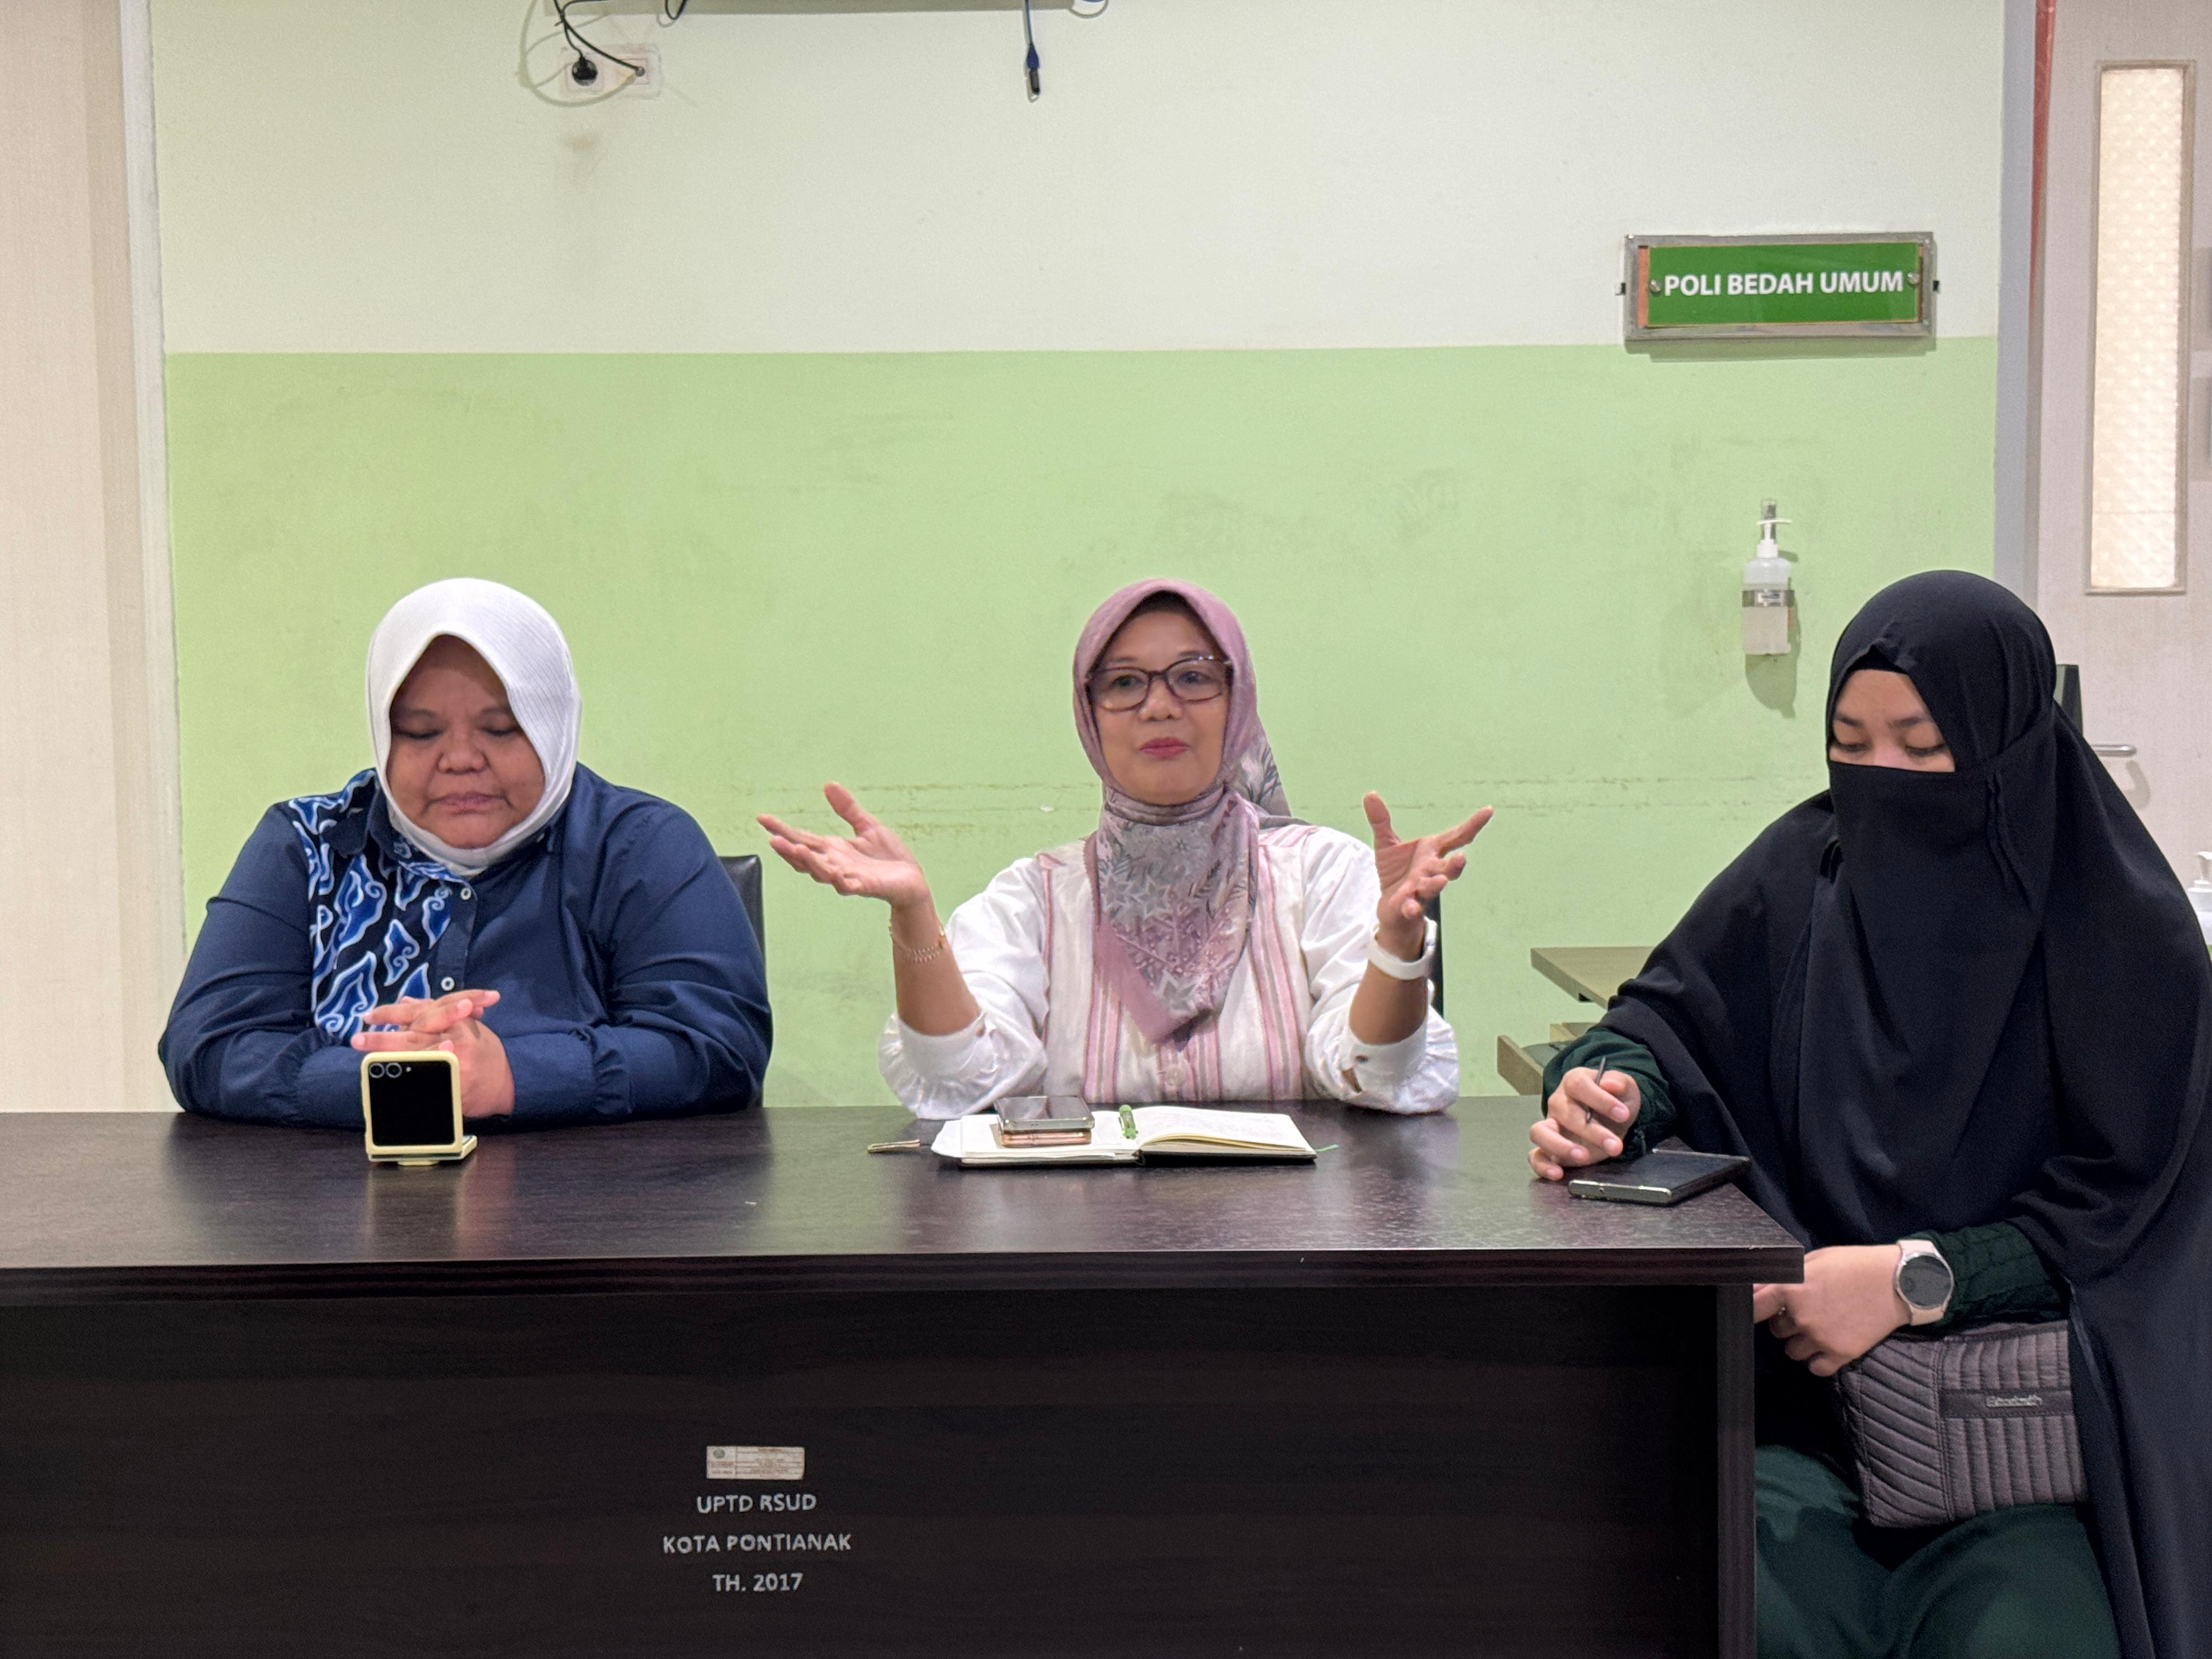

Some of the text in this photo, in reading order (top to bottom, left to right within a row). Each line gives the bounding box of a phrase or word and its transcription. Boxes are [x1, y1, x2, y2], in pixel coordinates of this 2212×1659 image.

[1664, 270, 1904, 296] POLI BEDAH UMUM
[696, 1493, 816, 1514] UPTD RSUD
[663, 1533, 851, 1554] KOTA PONTIANAK
[712, 1573, 803, 1592] TH. 2017
